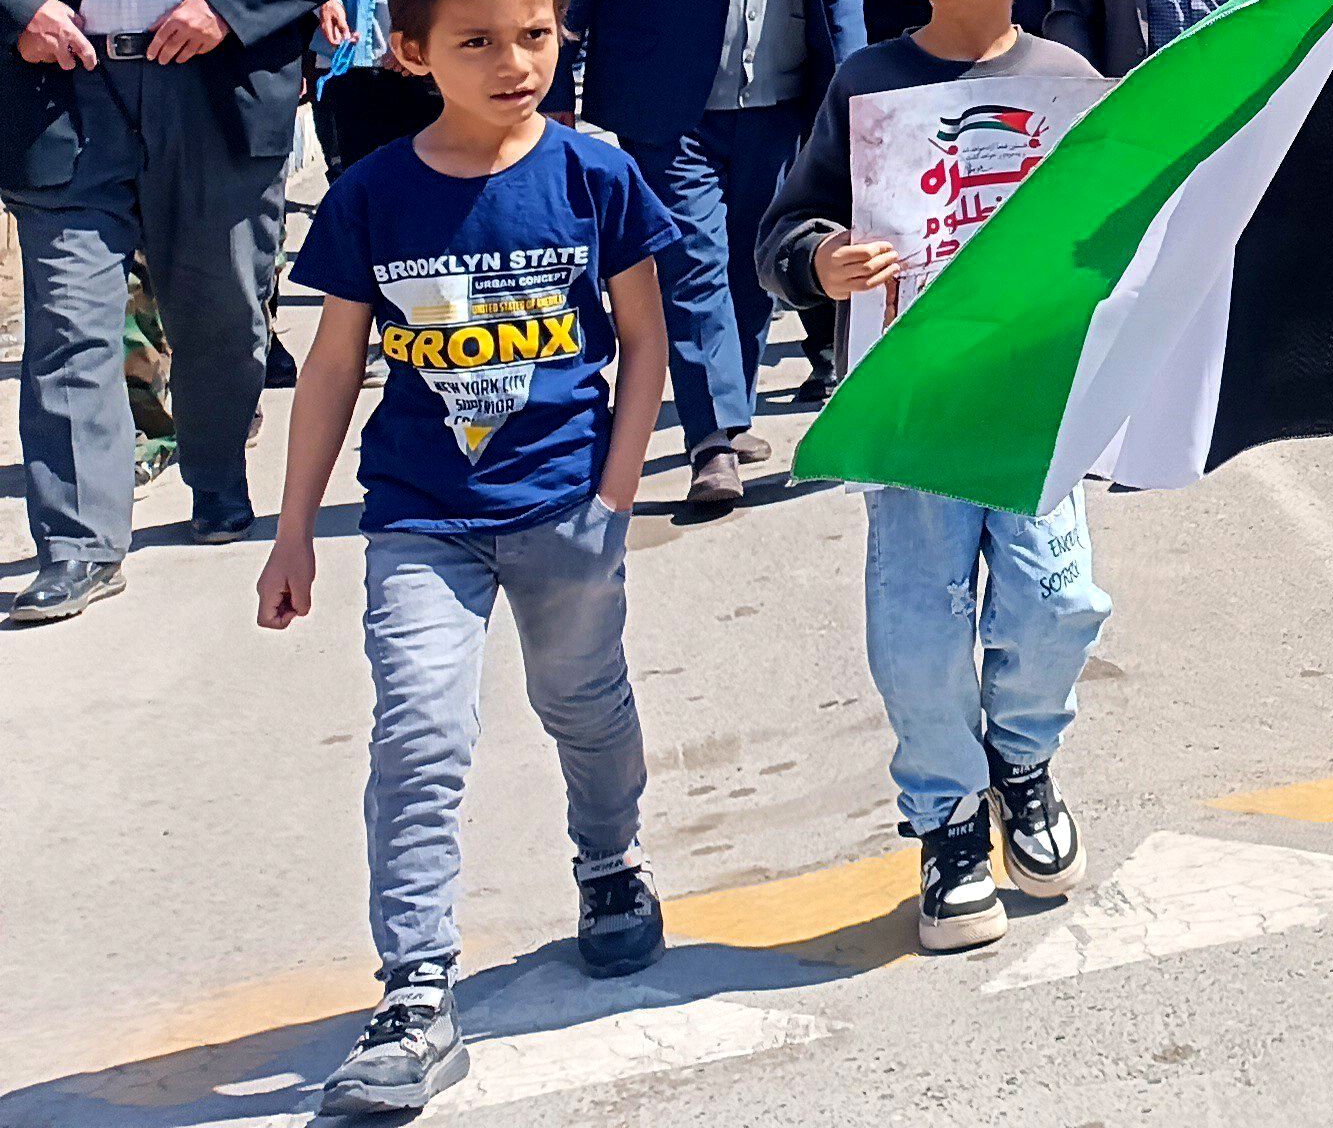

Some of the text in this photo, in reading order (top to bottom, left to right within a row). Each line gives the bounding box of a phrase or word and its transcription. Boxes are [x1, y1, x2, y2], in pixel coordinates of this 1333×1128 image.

[922, 192, 1003, 239] ظلوم
[373, 245, 589, 282] BROOKLYN STATE
[475, 271, 567, 290] URBAN CONCEPT
[383, 312, 580, 368] BRONX
[433, 374, 527, 396] NEW YORK CITY
[948, 822, 975, 838] NIKE
